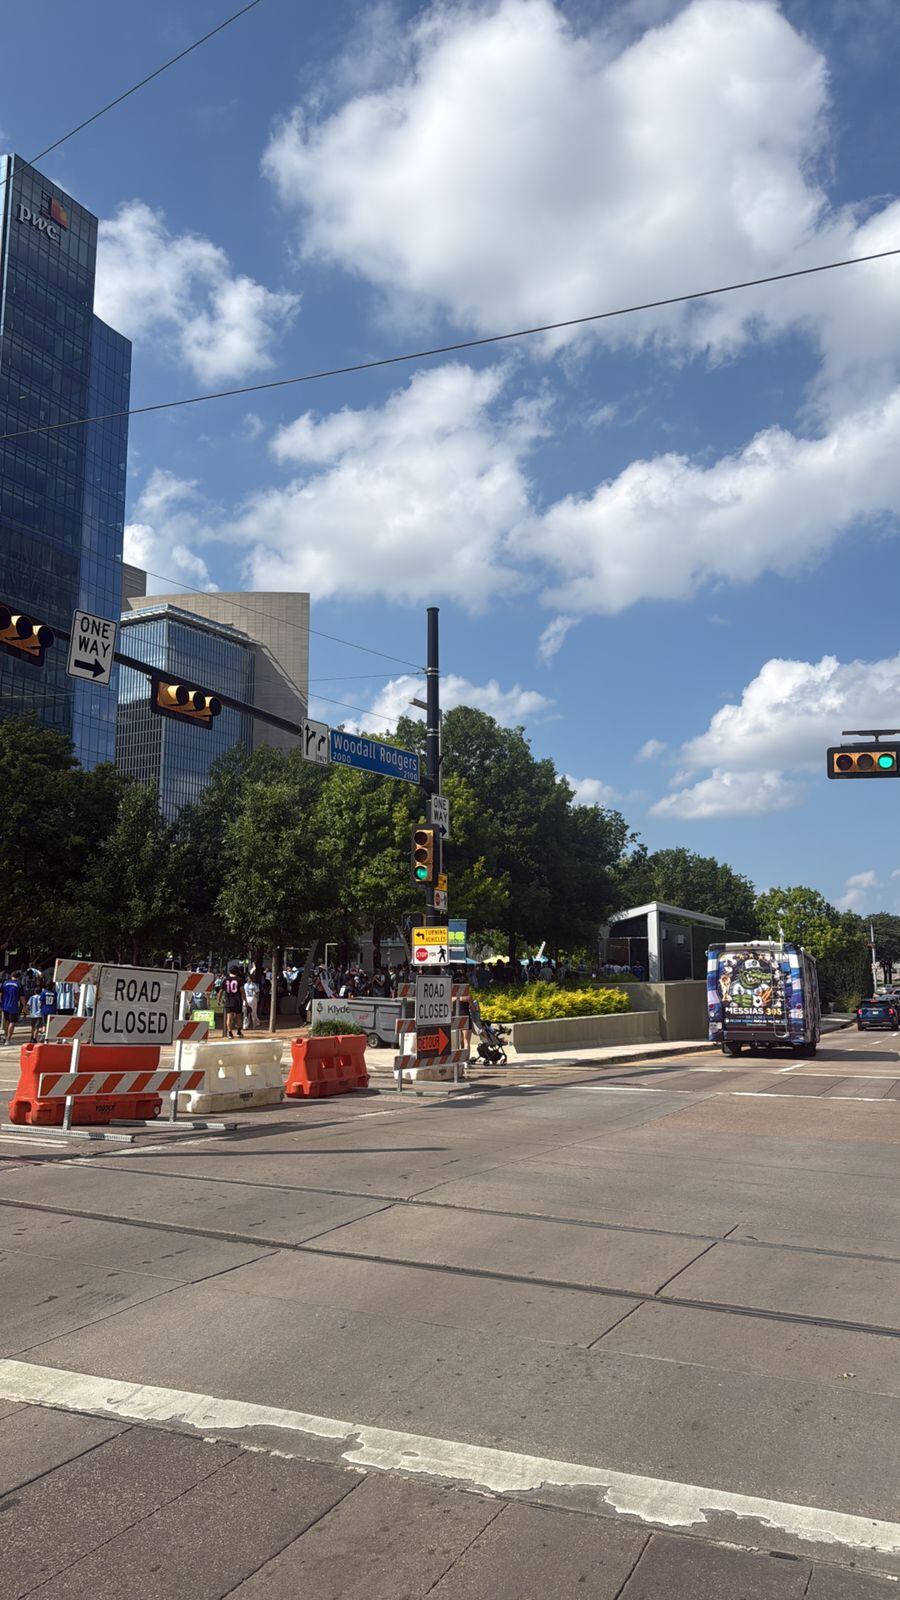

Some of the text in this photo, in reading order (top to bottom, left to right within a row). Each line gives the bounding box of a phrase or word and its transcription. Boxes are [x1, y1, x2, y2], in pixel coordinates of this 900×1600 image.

[18, 203, 59, 240] pwc
[81, 617, 110, 639] ONE
[78, 635, 110, 658] WAY
[333, 733, 417, 771] Woodall Rodgers
[333, 752, 351, 763] 2000
[404, 771, 418, 780] 2100
[433, 797, 447, 811] ONE
[433, 810, 448, 825] WAY
[114, 978, 161, 1003] ROAD
[225, 980, 238, 993] 10
[423, 983, 445, 998] ROAD
[45, 996, 54, 1005] 10
[327, 1002, 351, 1015] Klyde
[418, 1003, 449, 1019] CLOSED
[725, 1007, 764, 1015] MESSIAS
[101, 1010, 168, 1034] CLOSED
[418, 1035, 440, 1050] DETOUR
